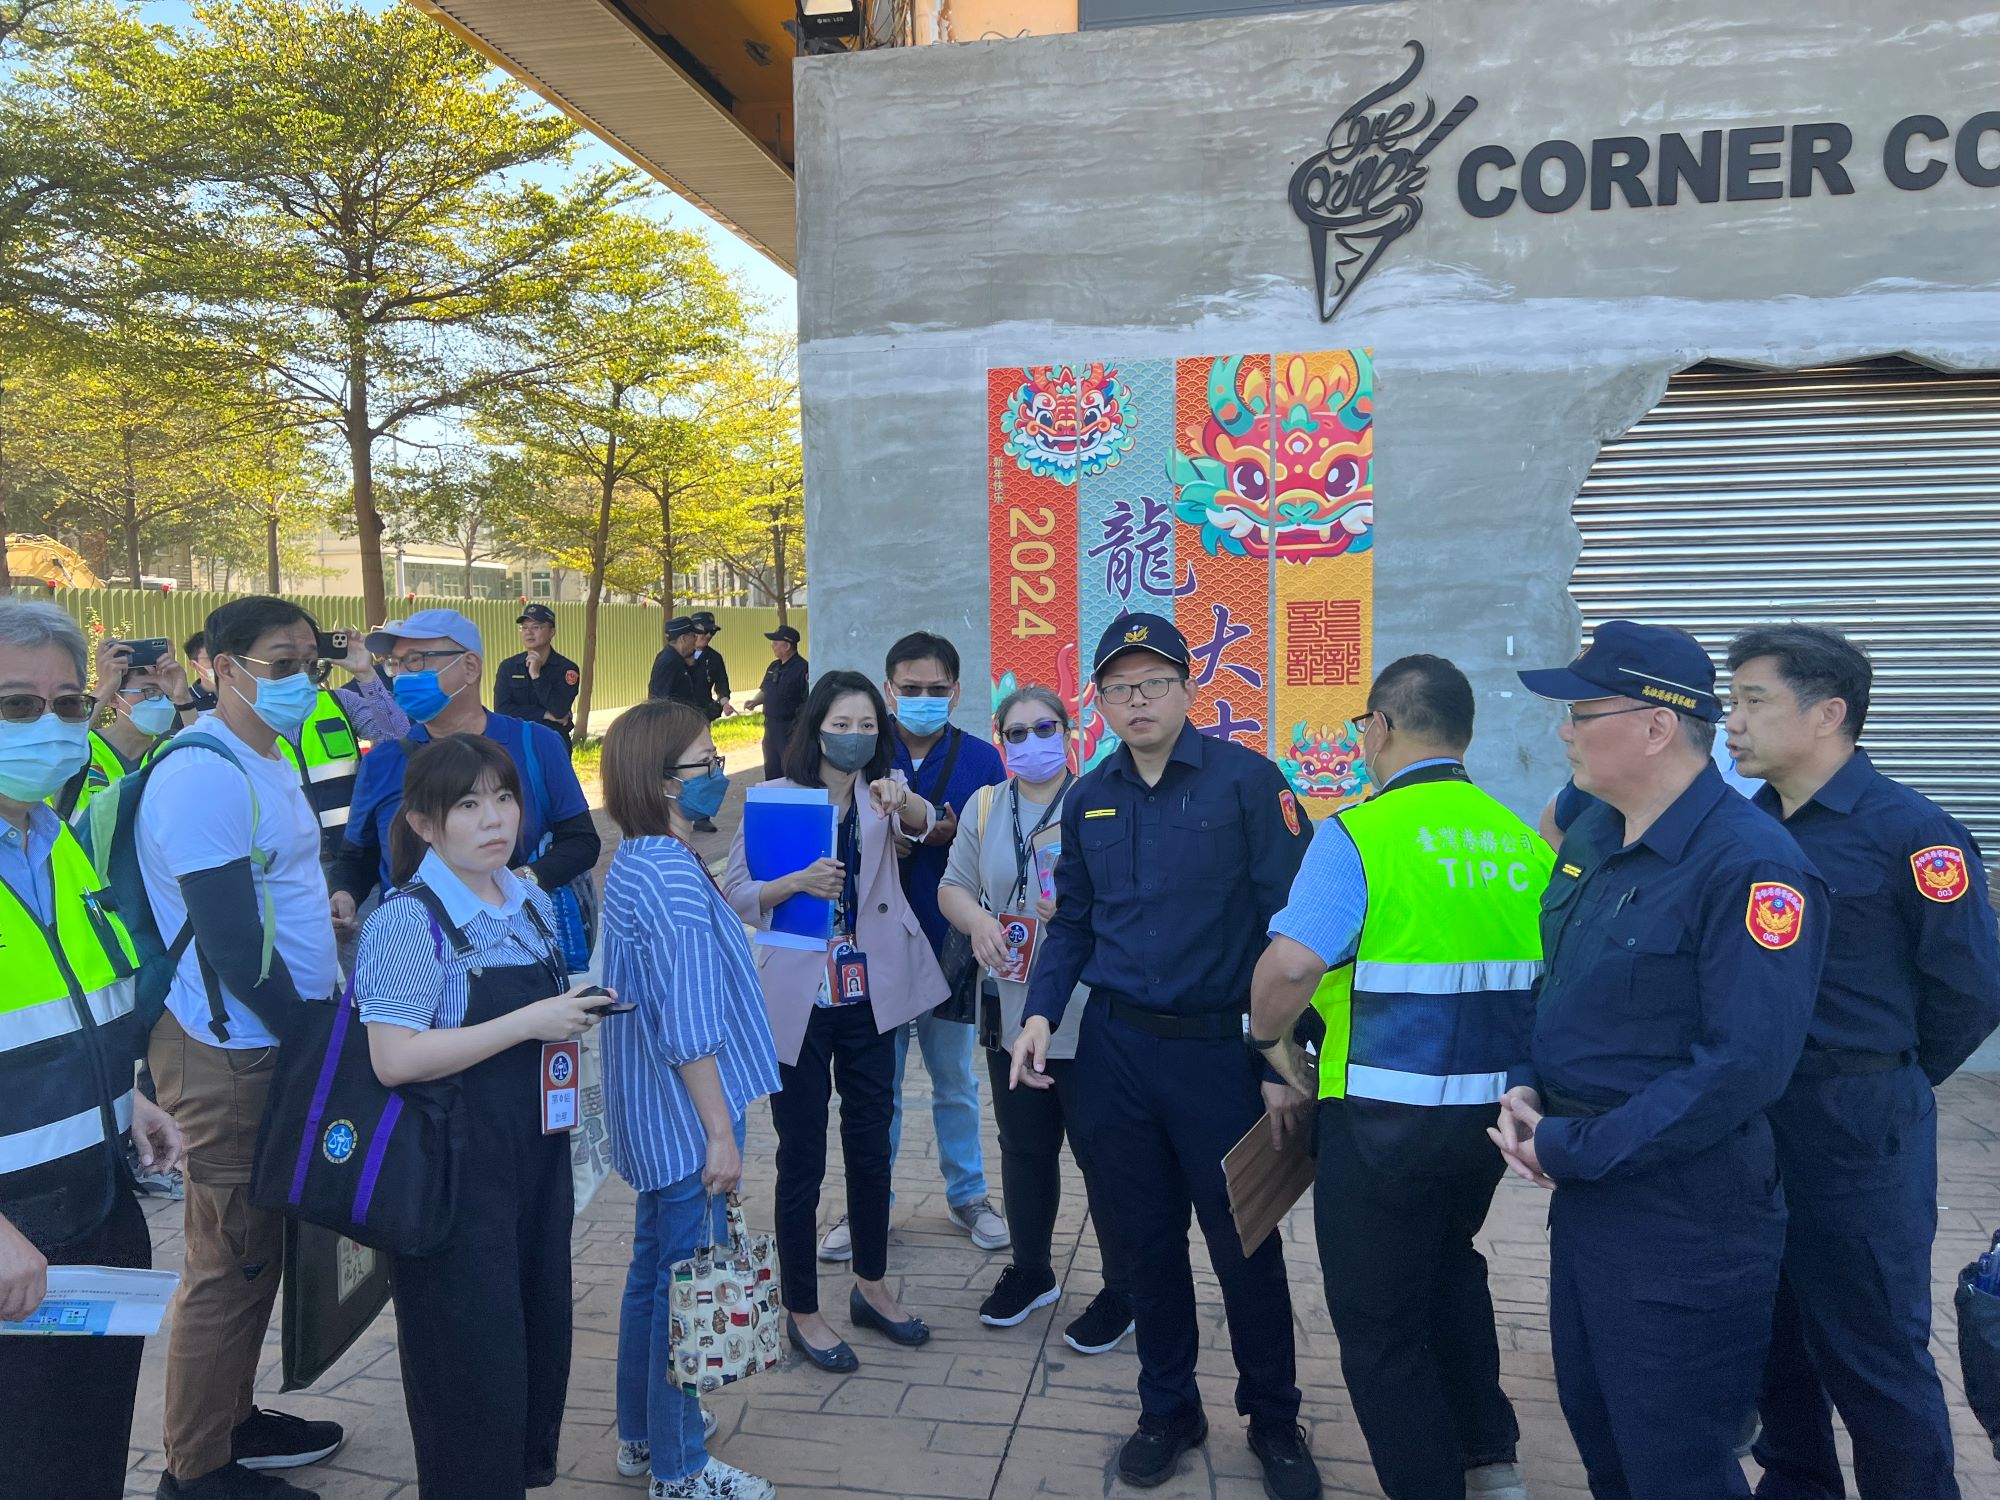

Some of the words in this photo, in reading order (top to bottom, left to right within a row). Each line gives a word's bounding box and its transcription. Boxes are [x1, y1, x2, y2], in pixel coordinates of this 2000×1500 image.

[1457, 122, 1855, 218] CORNER
[1883, 111, 2000, 190] CO
[1009, 507, 1057, 640] 2024
[1762, 932, 1780, 944] 008
